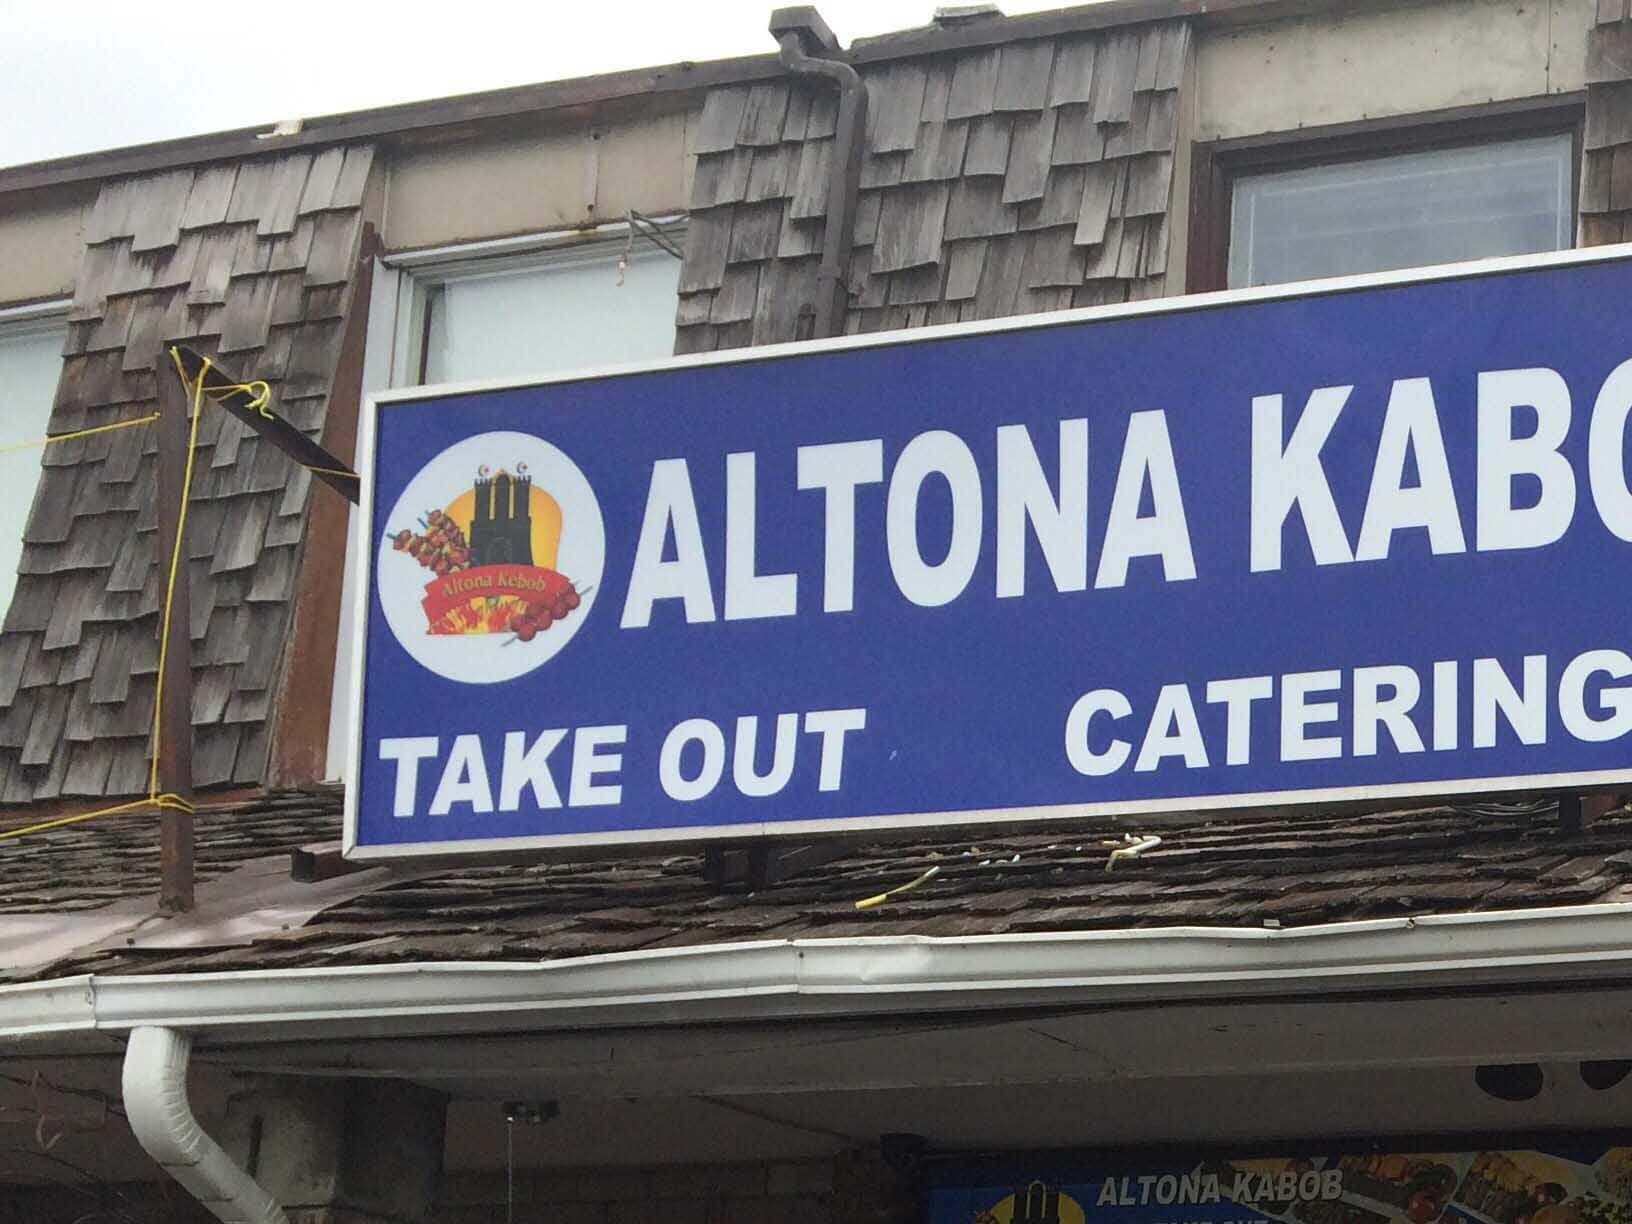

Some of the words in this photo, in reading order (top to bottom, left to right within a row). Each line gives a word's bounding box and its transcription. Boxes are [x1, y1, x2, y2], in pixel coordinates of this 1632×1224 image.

[620, 409, 1197, 629] ALTONA
[443, 576, 492, 596] Altona
[379, 725, 628, 817] TAKE
[659, 708, 866, 801] OUT
[1096, 1172, 1222, 1208] ALTONA
[1232, 1168, 1345, 1205] KABOB
